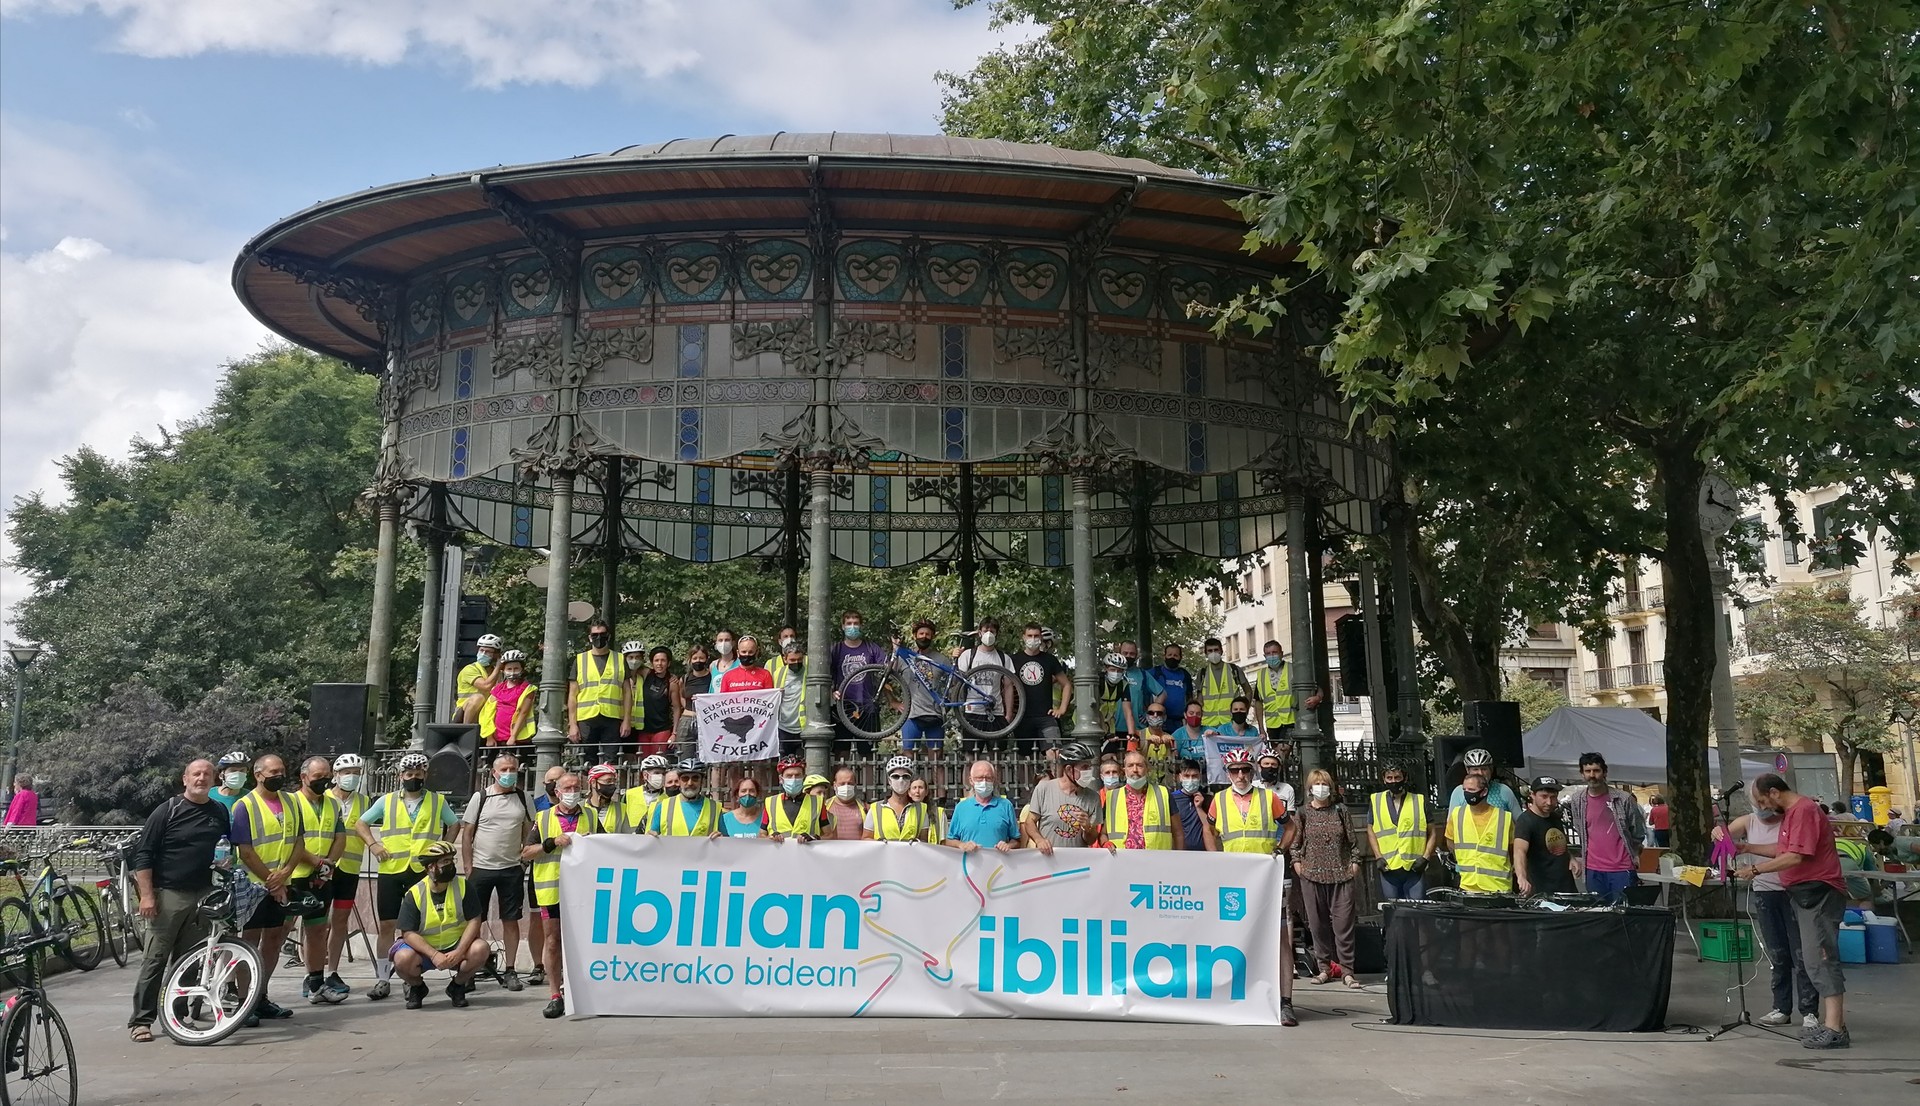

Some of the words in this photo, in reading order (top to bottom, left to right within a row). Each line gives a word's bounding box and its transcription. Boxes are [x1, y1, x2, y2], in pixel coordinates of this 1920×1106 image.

[702, 697, 740, 715] EUSKAL
[743, 697, 775, 710] PRESO
[704, 712, 719, 725] ETA
[720, 706, 774, 720] IHESLARIAK
[711, 740, 769, 756] ETXERA
[1158, 881, 1192, 896] izan
[591, 867, 861, 950] ibilian
[1158, 896, 1204, 911] bidea
[978, 915, 1248, 1001] ibilian
[589, 955, 735, 985] etxerako
[744, 956, 857, 988] bidean
